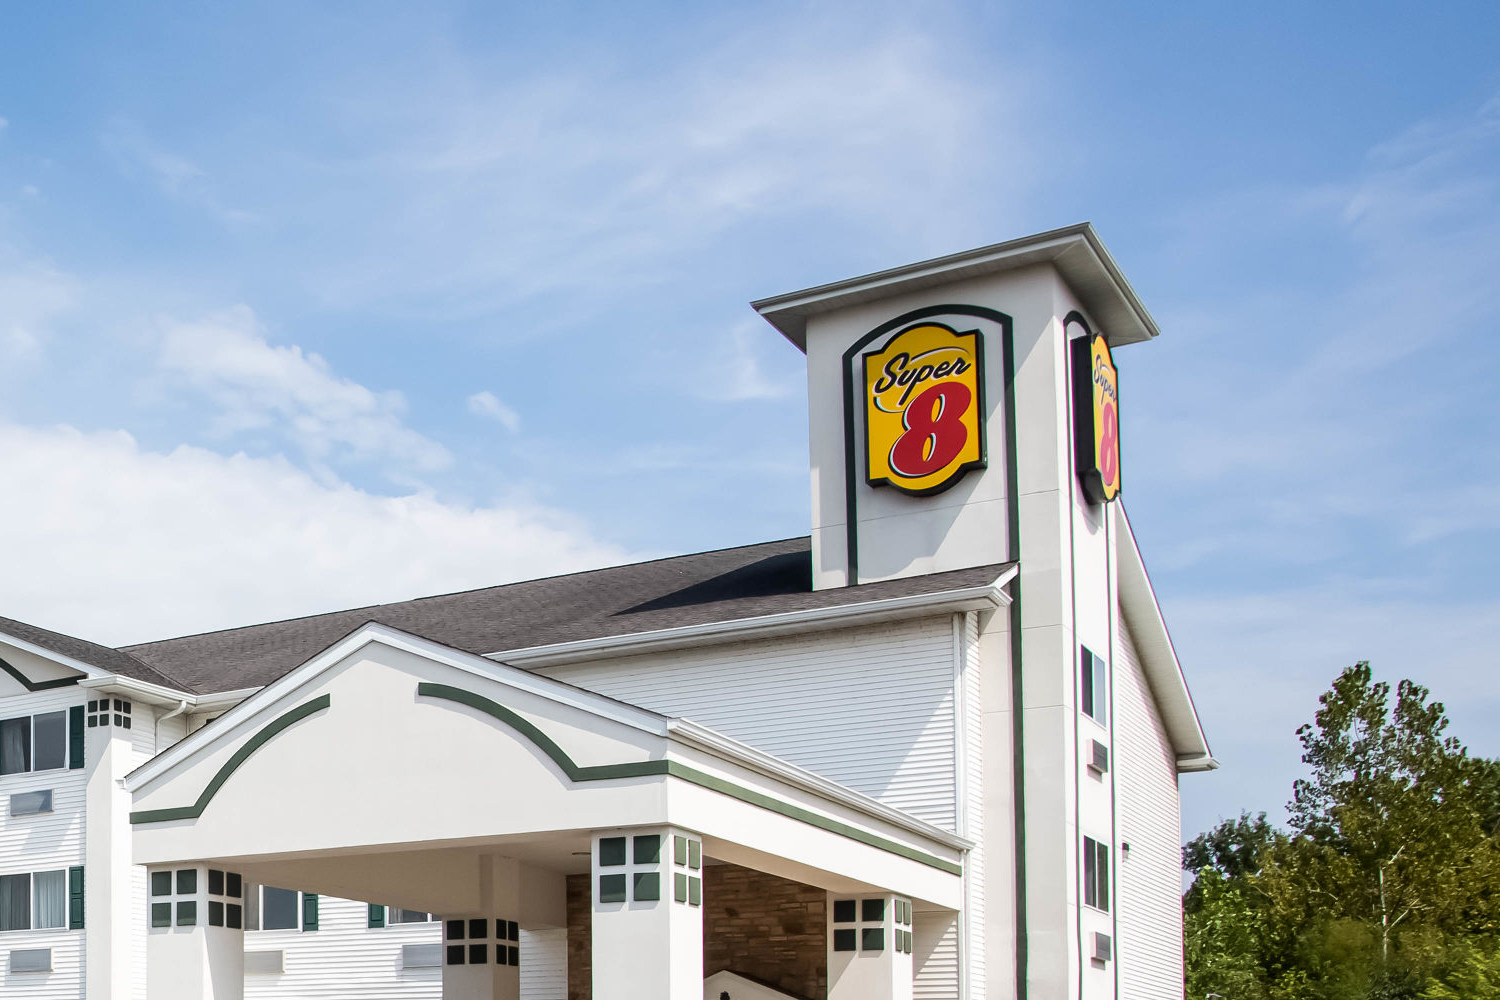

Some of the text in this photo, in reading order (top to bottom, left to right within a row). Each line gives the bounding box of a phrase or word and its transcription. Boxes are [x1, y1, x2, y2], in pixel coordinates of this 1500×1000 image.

[873, 352, 971, 407] Super
[1093, 354, 1117, 405] Super
[888, 381, 972, 479] 8
[1100, 402, 1117, 487] 8
